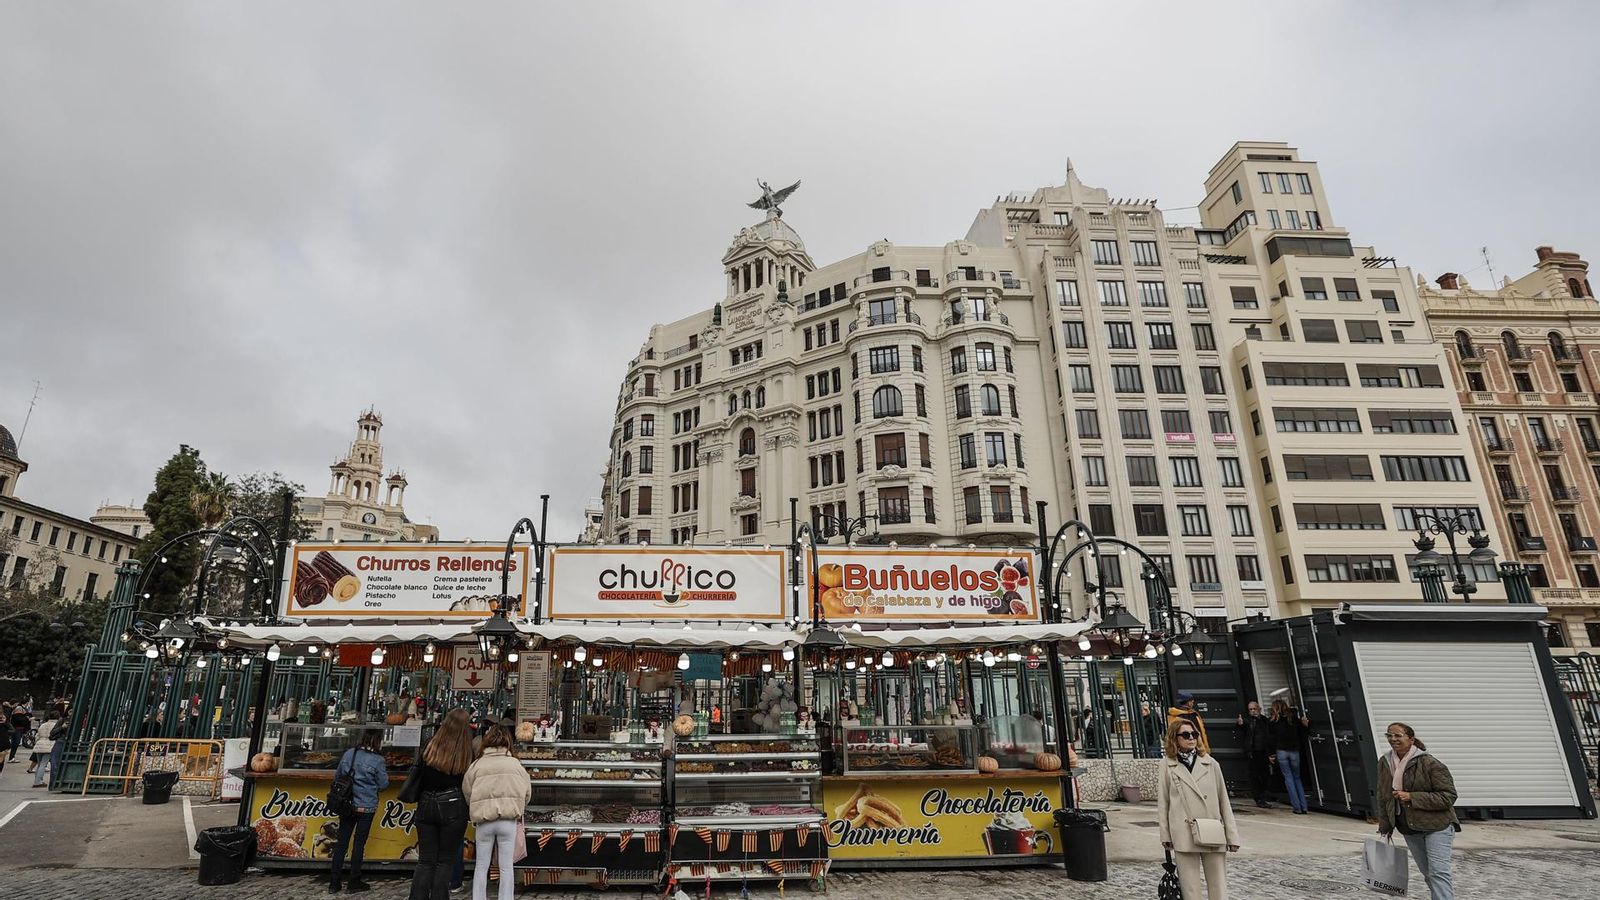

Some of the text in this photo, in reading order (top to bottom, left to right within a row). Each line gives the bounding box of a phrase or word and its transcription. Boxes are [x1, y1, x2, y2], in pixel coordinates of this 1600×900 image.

[356, 555, 431, 571] Churros
[459, 575, 492, 583] pastelera
[844, 563, 999, 591] Buñuelos
[844, 594, 1001, 609] de calabaza y de higo
[457, 657, 493, 671] CAJA
[150, 744, 165, 752] SPV
[921, 787, 1051, 816] Chocolatería
[826, 820, 941, 848] Churrería
